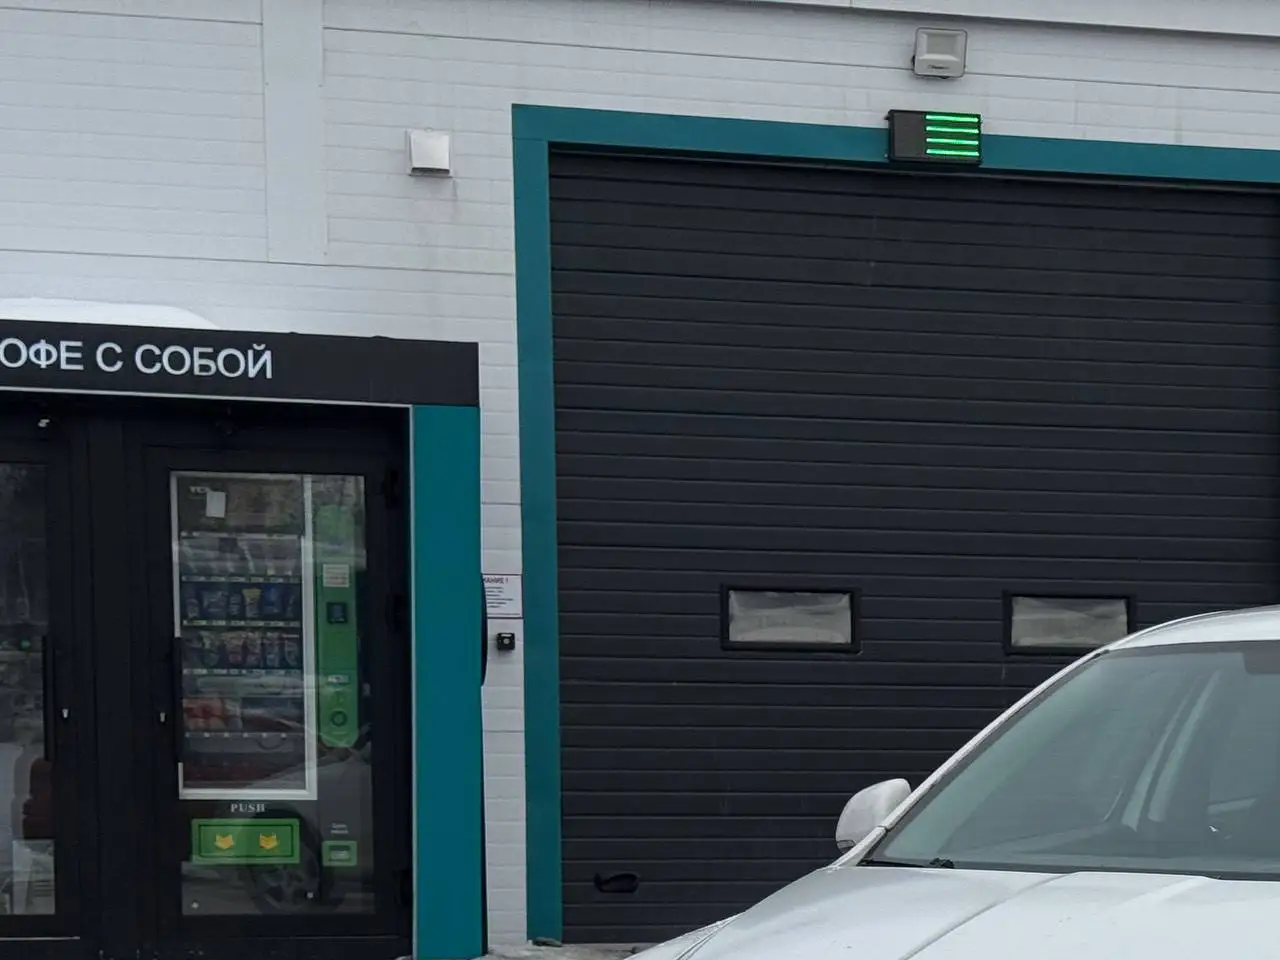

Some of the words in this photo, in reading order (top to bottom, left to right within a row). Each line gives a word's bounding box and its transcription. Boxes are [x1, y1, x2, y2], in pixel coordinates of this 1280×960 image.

[96, 342, 124, 372] С
[135, 343, 273, 379] СОБОЙ
[230, 803, 266, 813] PUSH
